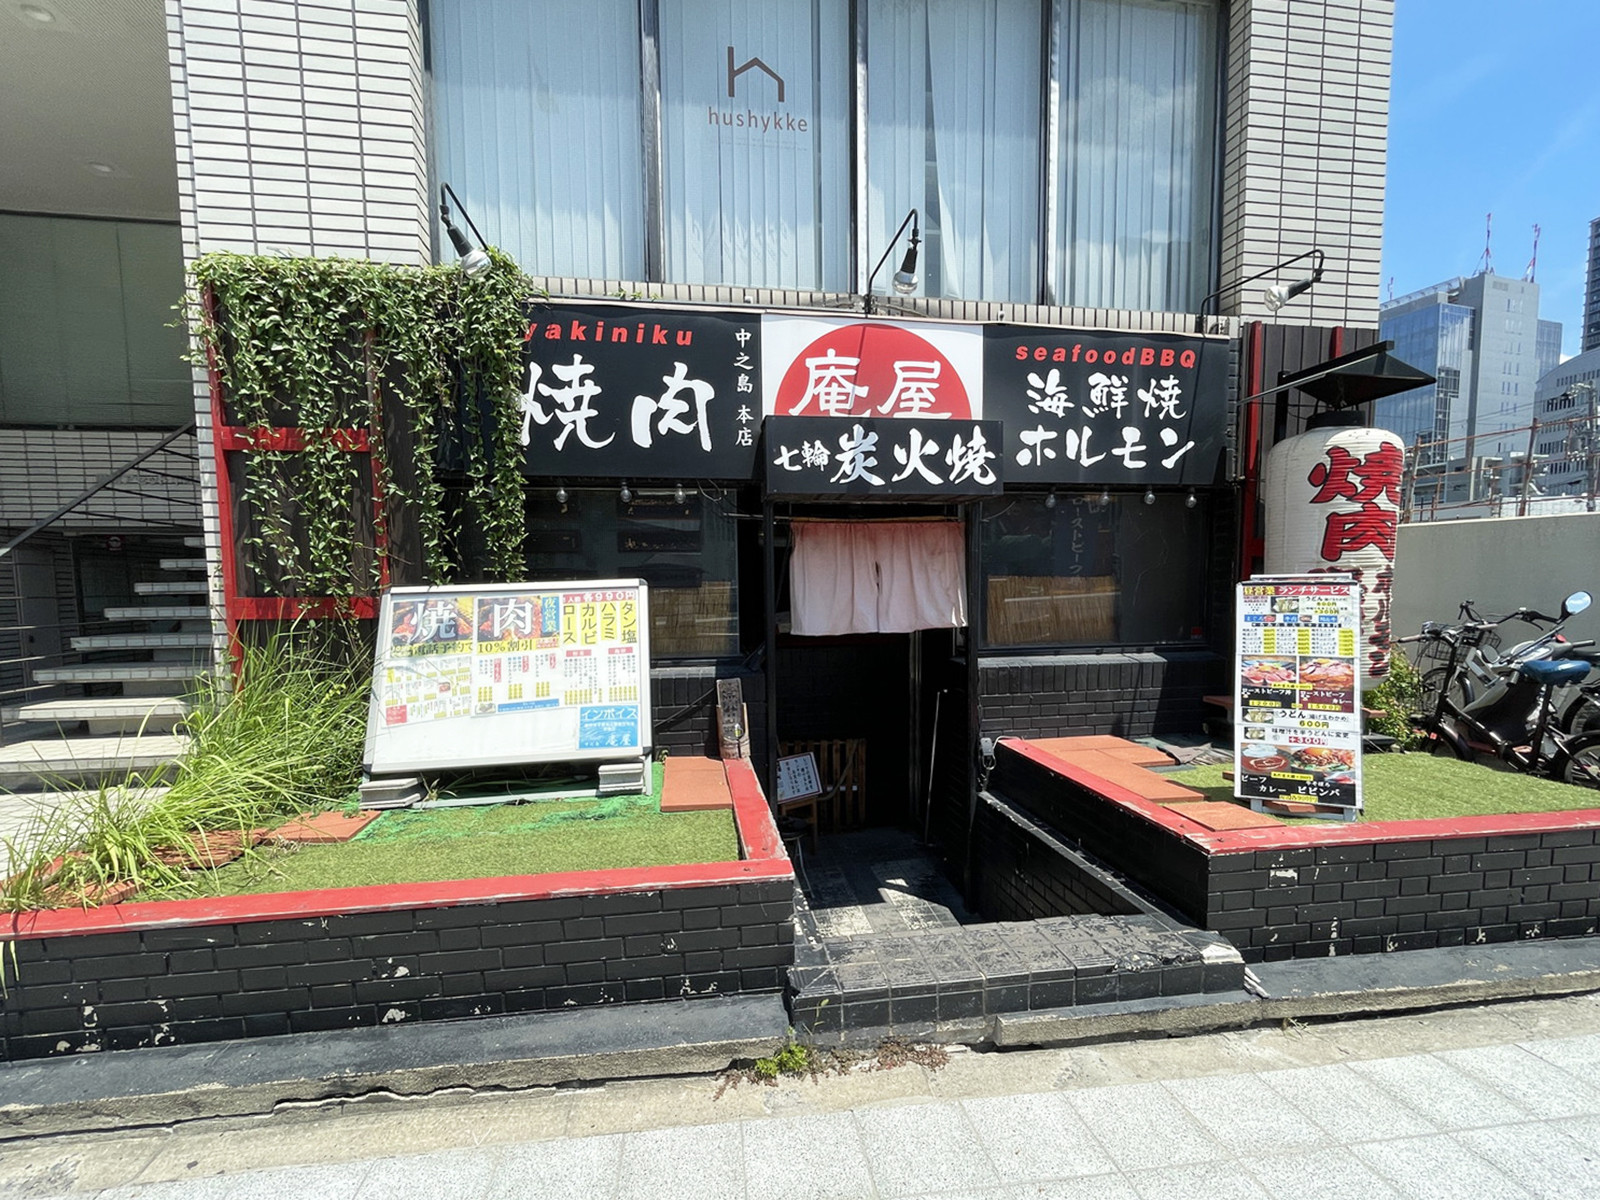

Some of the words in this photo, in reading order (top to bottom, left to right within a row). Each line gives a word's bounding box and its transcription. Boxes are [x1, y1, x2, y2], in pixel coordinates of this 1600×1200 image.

[708, 106, 808, 134] hushykke
[524, 320, 693, 346] yakiniku
[735, 327, 755, 394] 中之島
[1015, 344, 1196, 369] seafoodBBQ
[788, 348, 953, 419] 庵屋
[1026, 368, 1188, 420] 海鮮焼
[520, 353, 716, 453] 焼肉
[735, 404, 754, 447] 本店
[1015, 425, 1196, 469] ホルモン
[1308, 441, 1403, 562] 焼肉
[1279, 585, 1350, 596] ランチサービス
[563, 605, 576, 644] ロース
[581, 603, 597, 645] カルビ
[601, 602, 616, 639] ハラミ
[621, 602, 638, 643] タン塩
[477, 639, 534, 654] 10%割引
[582, 708, 638, 720] インボイス
[1279, 710, 1306, 719] うどん
[1299, 720, 1329, 728] 600円
[1242, 775, 1267, 783] ビーフ
[1259, 785, 1288, 793] カレー
